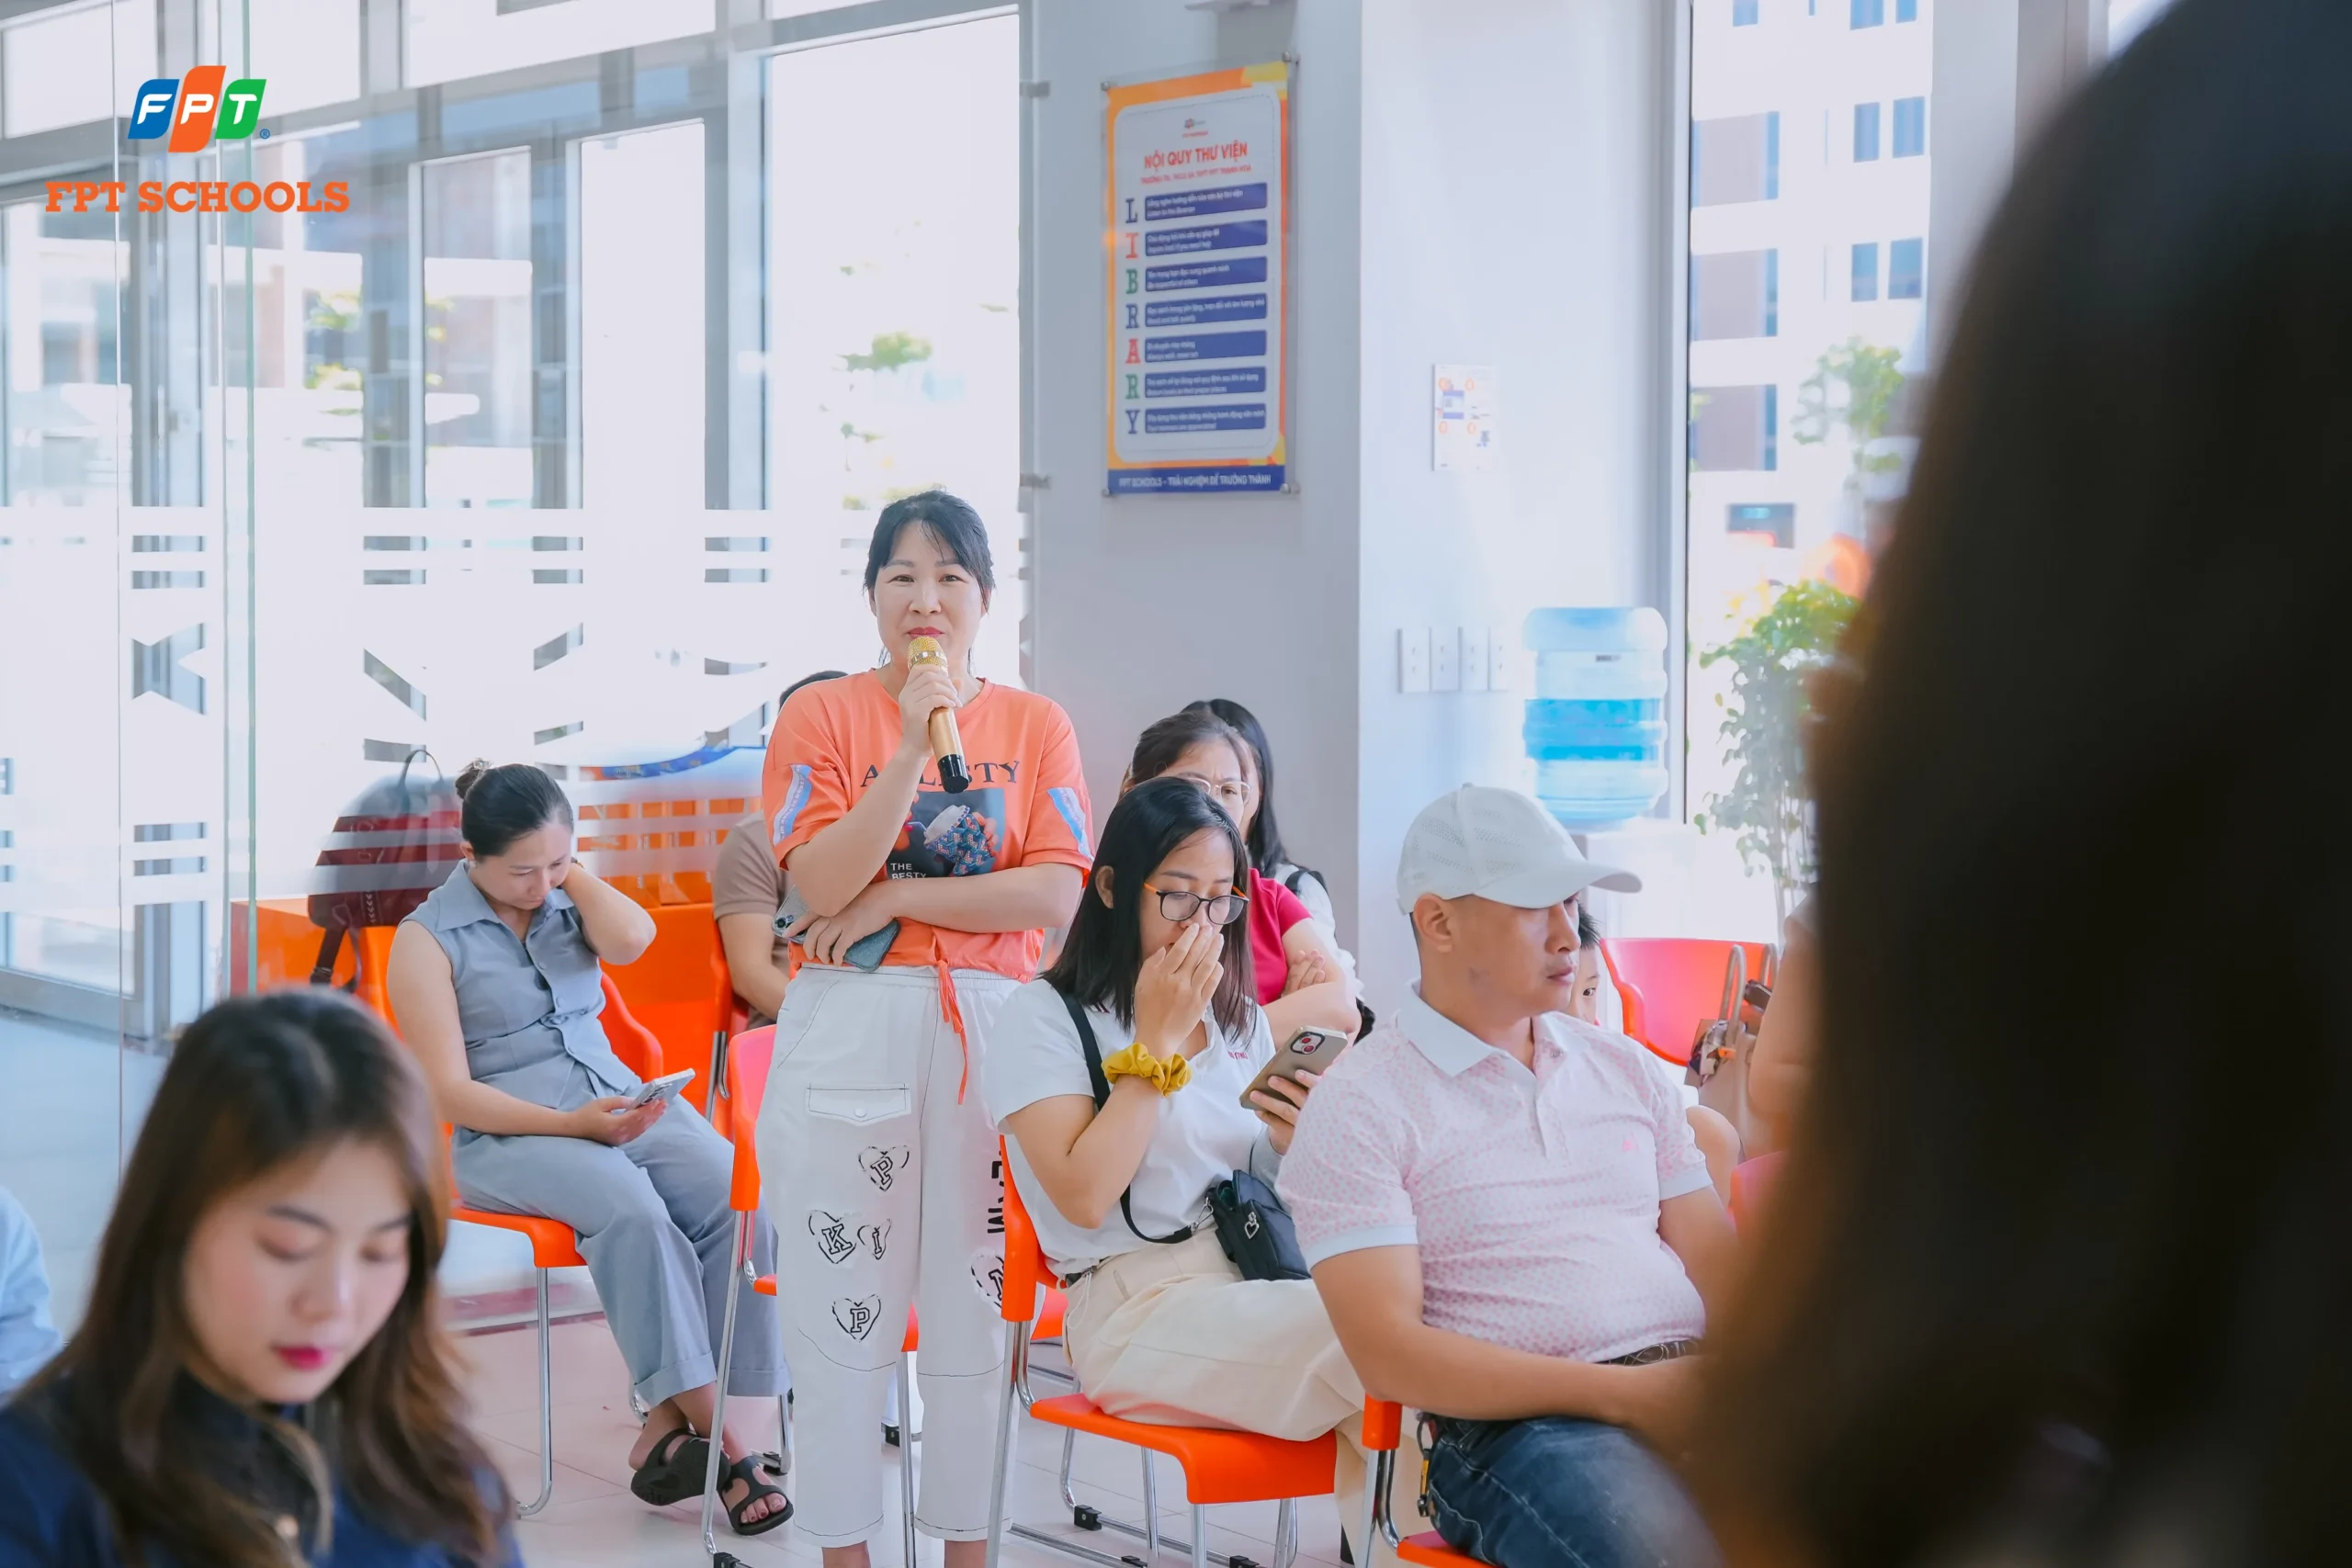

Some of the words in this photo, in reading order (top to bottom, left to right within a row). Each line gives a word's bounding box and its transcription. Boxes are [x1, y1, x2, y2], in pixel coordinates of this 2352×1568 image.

[1144, 149, 1164, 172] NỘI
[1167, 149, 1193, 166] QUY
[1195, 143, 1219, 163] THƯ
[1221, 140, 1248, 163] VIỆN
[890, 863, 912, 872] THE
[870, 1156, 893, 1186] P
[821, 1224, 853, 1255] K
[850, 1307, 870, 1333] P
